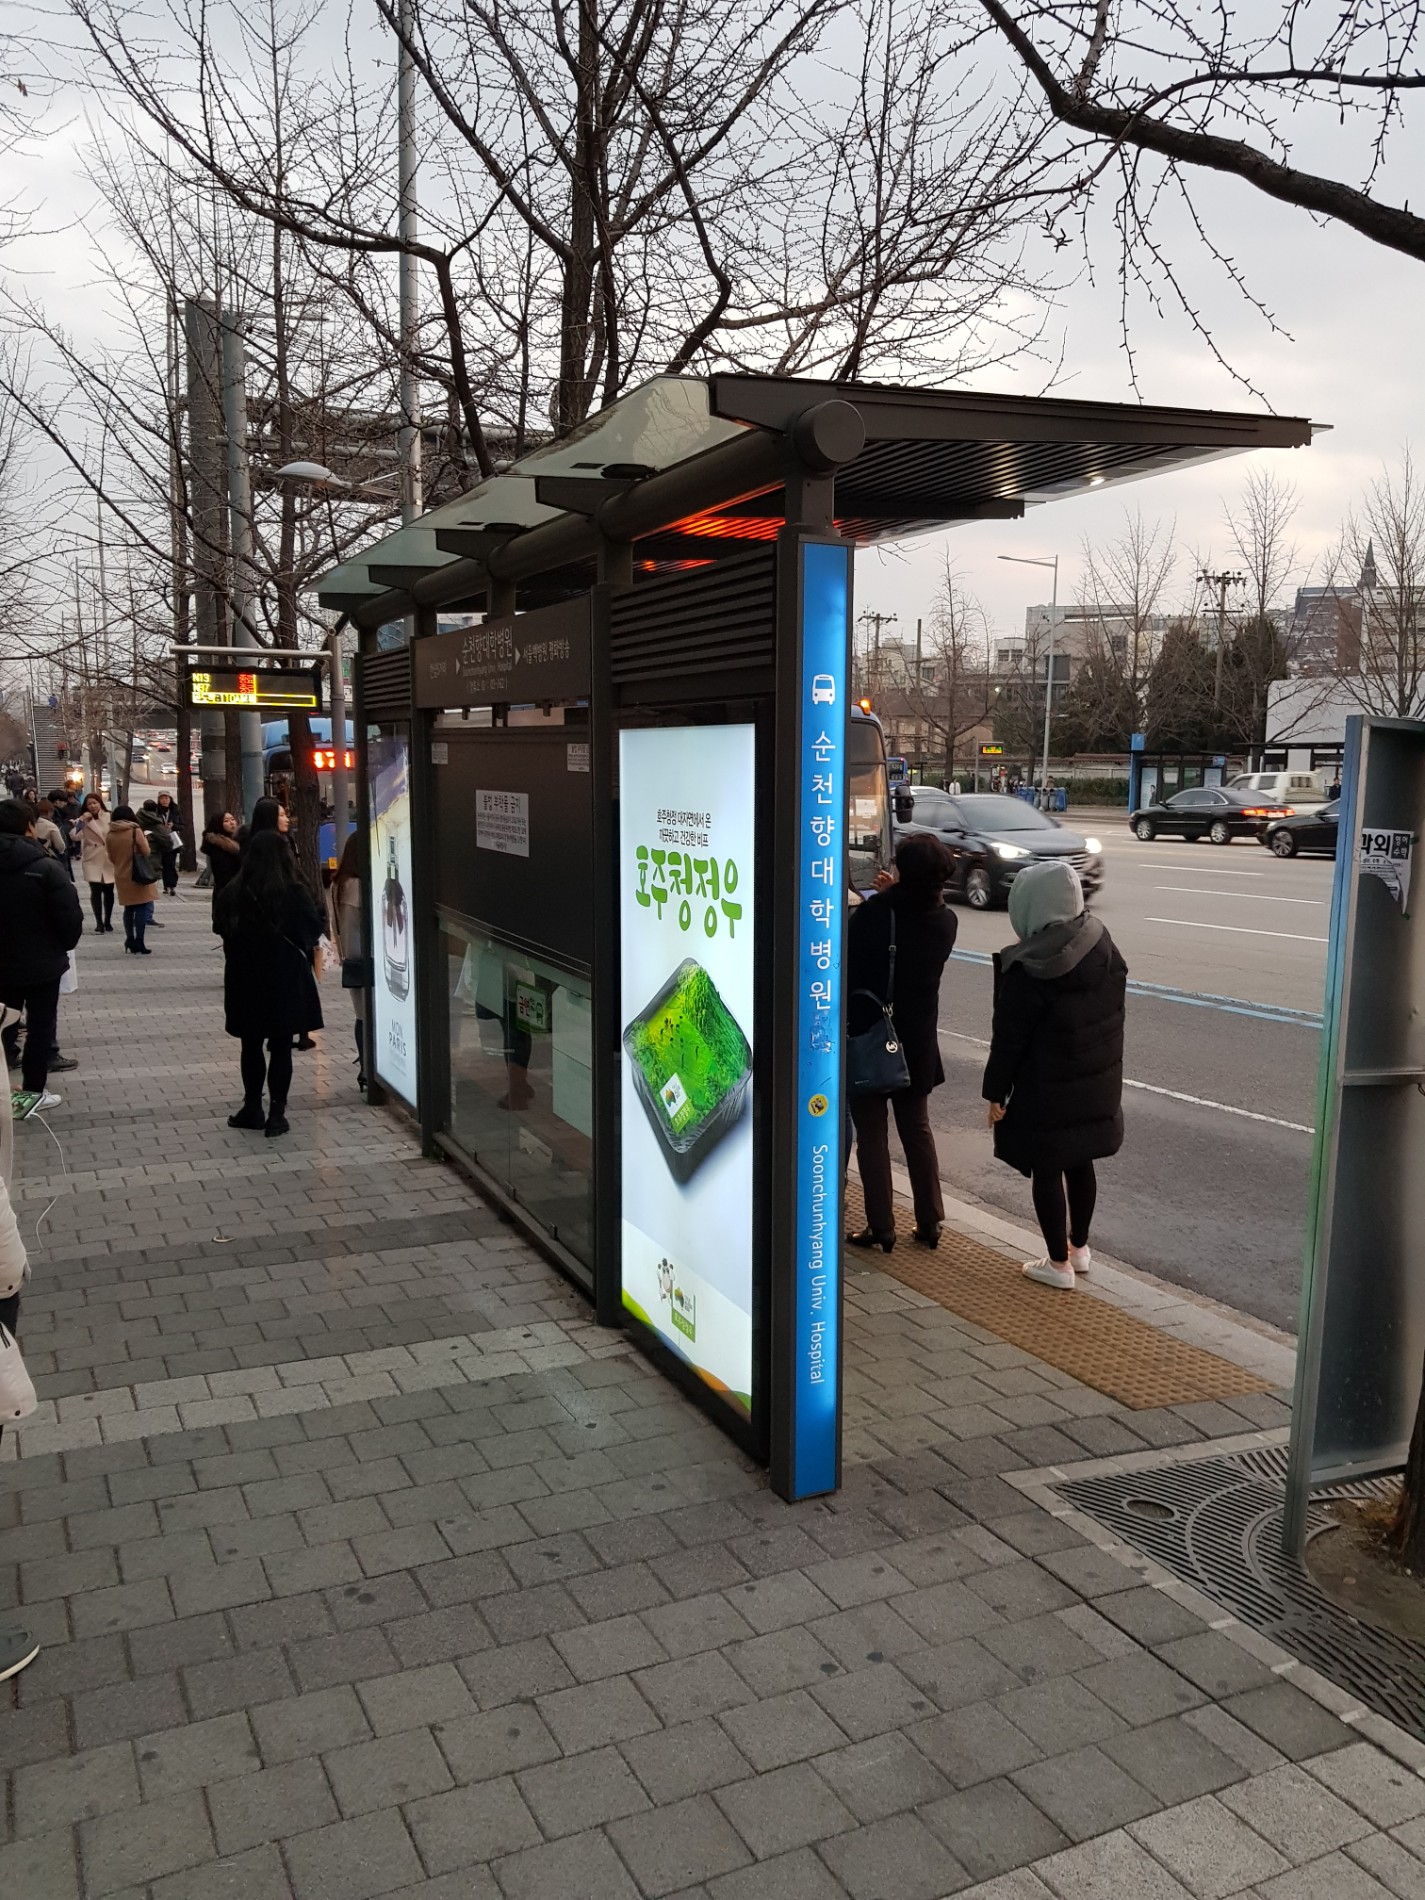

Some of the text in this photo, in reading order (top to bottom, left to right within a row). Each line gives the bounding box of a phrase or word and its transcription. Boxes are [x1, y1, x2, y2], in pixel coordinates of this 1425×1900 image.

[462, 626, 513, 664] 순천향대학병원
[192, 673, 210, 682] N13
[677, 811, 705, 829] 대자연에서
[704, 814, 712, 829] 온
[679, 830, 697, 847] 건강한
[809, 731, 836, 1010] 순천향대학병원
[635, 845, 743, 939] 호주청정우
[388, 1031, 407, 1056] PARIS
[808, 1144, 829, 1385] Soonchunhyang Univ. Hospital
